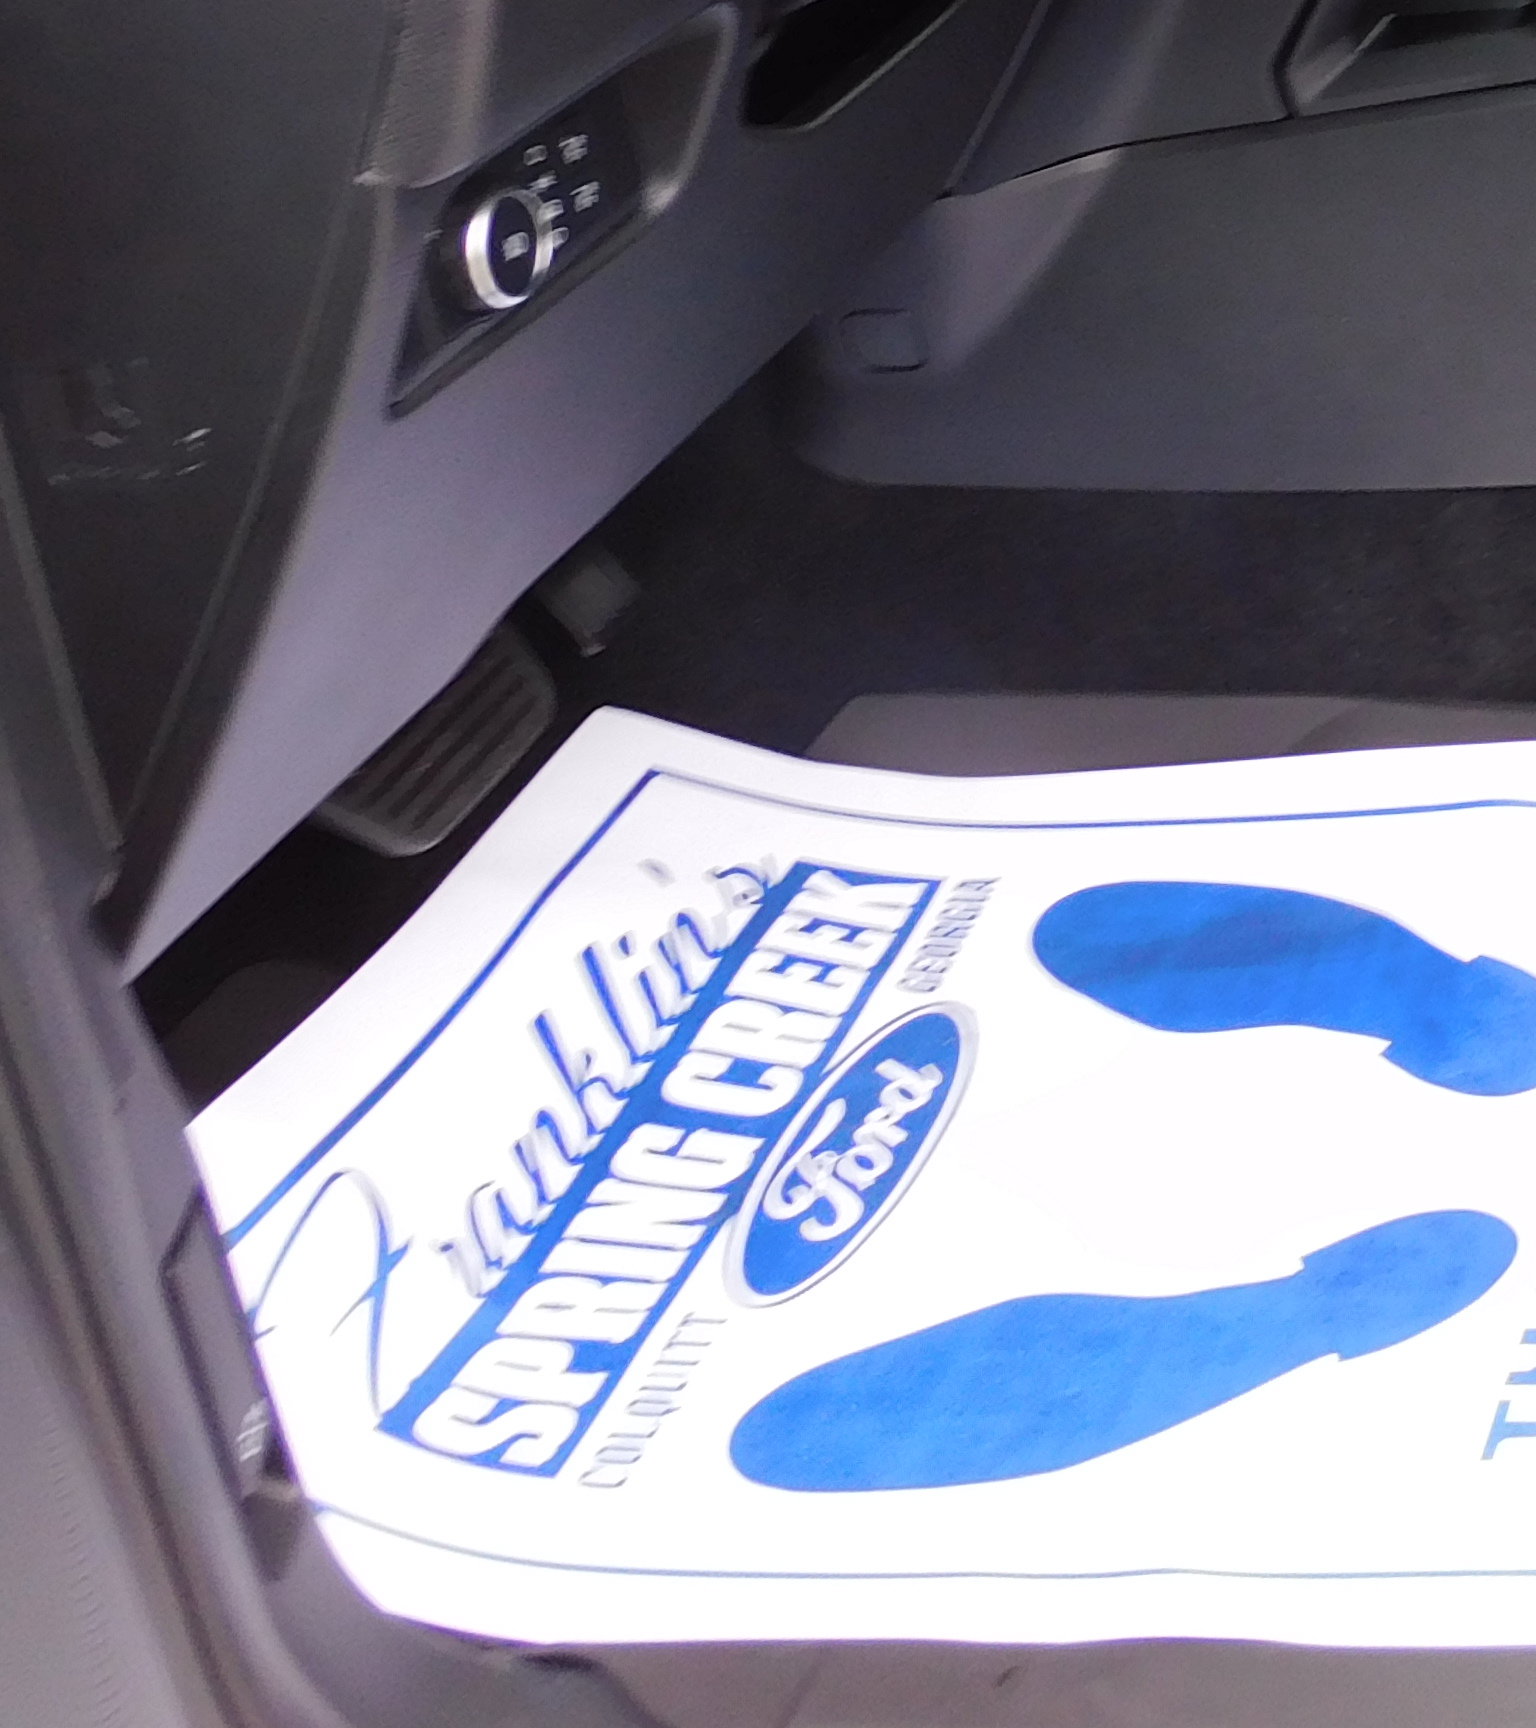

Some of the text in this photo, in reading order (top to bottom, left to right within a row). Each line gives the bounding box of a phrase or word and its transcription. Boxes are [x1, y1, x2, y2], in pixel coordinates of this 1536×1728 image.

[895, 876, 1001, 993] GEORGIA
[247, 855, 776, 1420] Franklin's
[412, 869, 930, 1467] SPRING CREEK
[762, 1057, 943, 1242] Ford
[579, 1311, 728, 1489] COLQUITT
